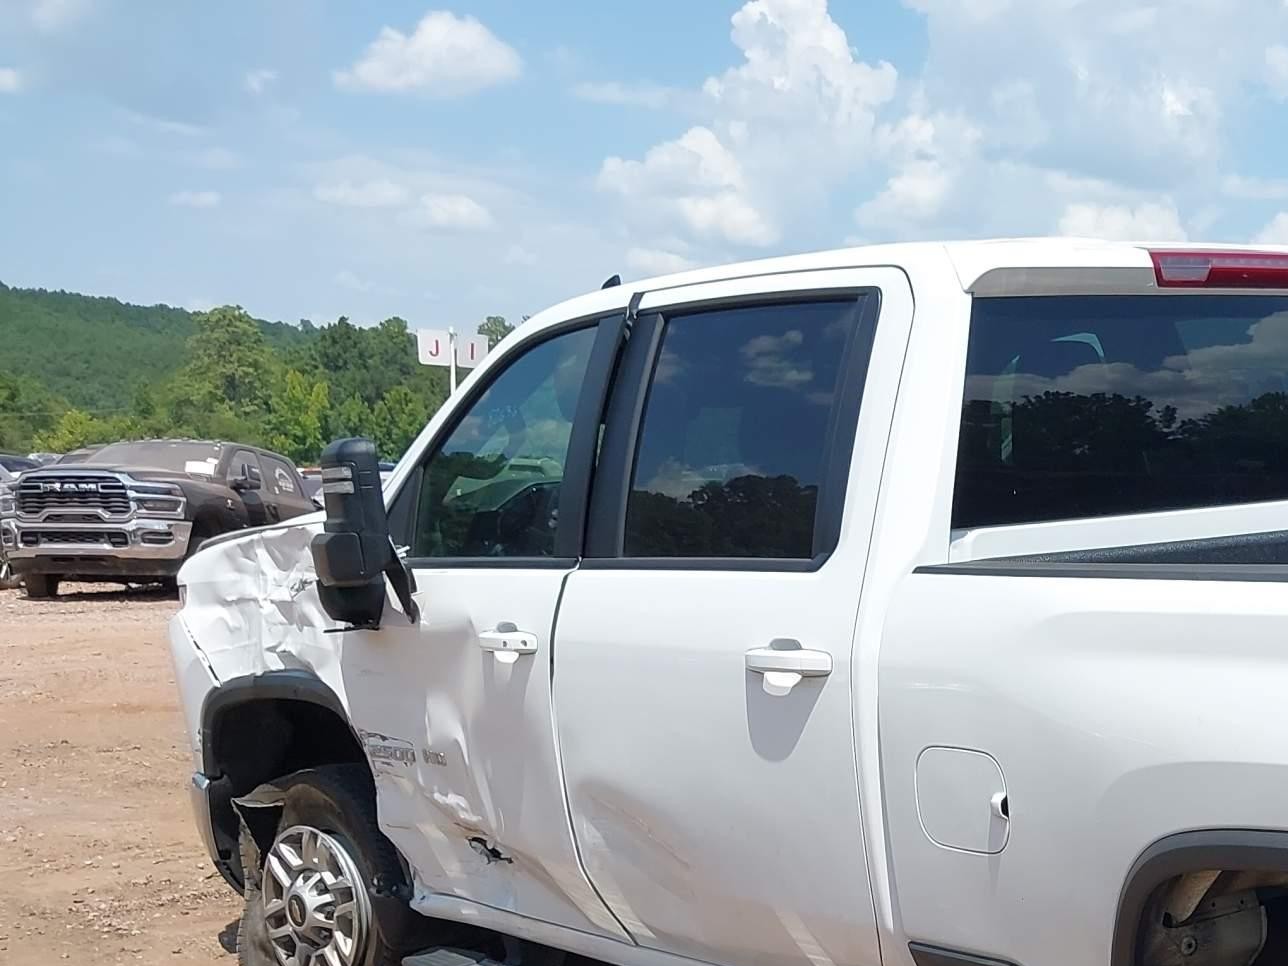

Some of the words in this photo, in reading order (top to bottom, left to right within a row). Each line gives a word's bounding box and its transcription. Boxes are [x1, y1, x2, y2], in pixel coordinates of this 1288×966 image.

[428, 339, 439, 357] J
[470, 343, 475, 360] I
[43, 482, 97, 493] RAM
